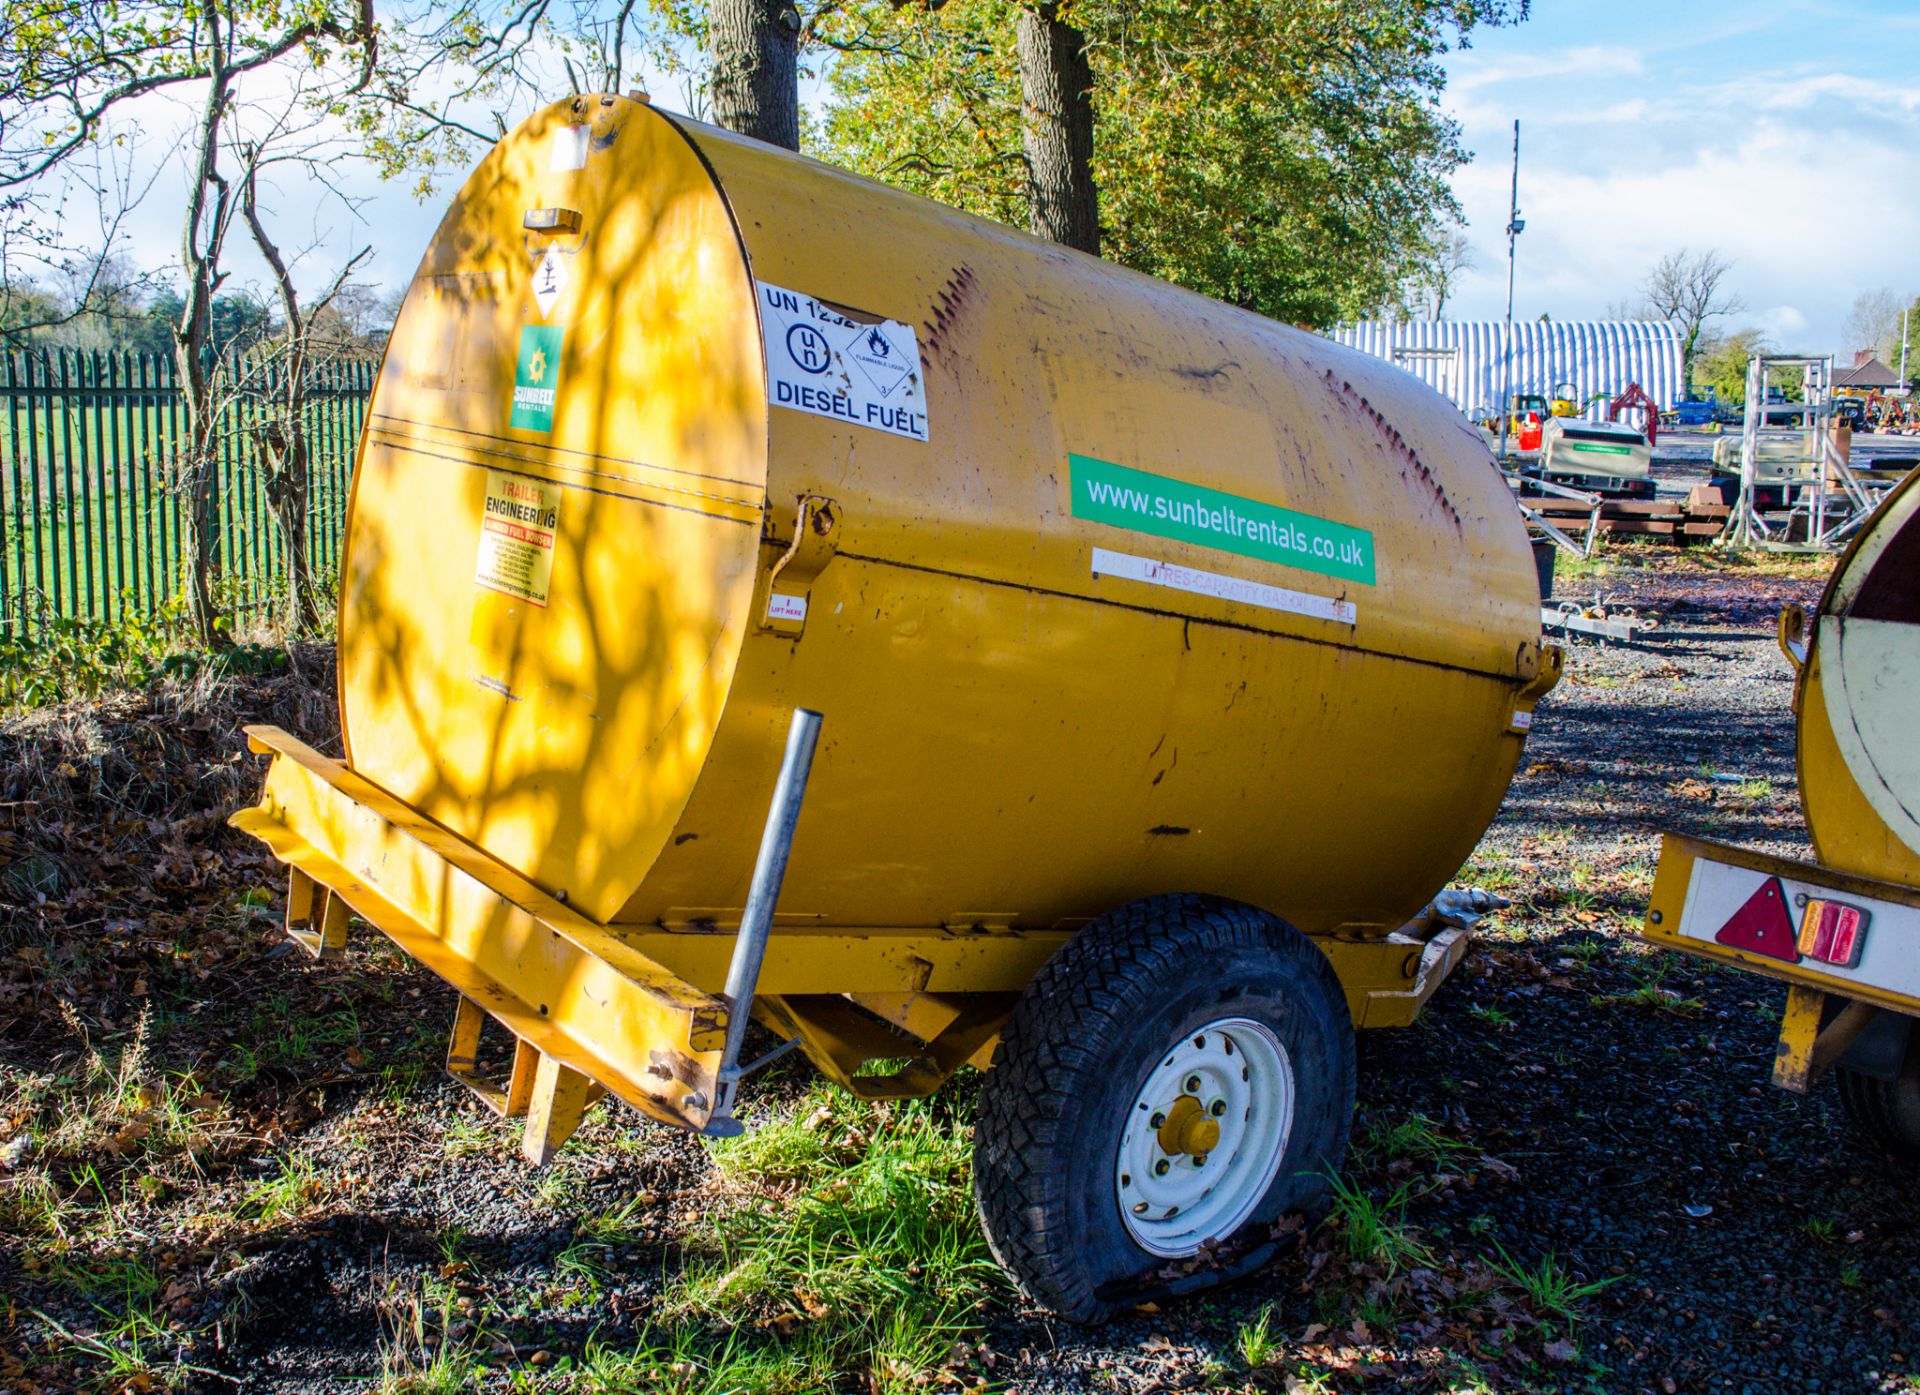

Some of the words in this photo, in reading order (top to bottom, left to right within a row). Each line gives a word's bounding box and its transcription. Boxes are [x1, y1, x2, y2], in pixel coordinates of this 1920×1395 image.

[766, 288, 798, 313] UN
[513, 385, 554, 405] SUNBELT
[881, 385, 887, 394] 3
[517, 402, 547, 413] RENTALS
[776, 380, 860, 419] DIESEL
[867, 402, 922, 435] FUEL
[502, 479, 545, 505] TRAILER
[486, 496, 557, 529] ENGINEERING
[1087, 479, 1364, 567] www.sunbeltrentals.co.uk
[771, 606, 784, 614] LIFT
